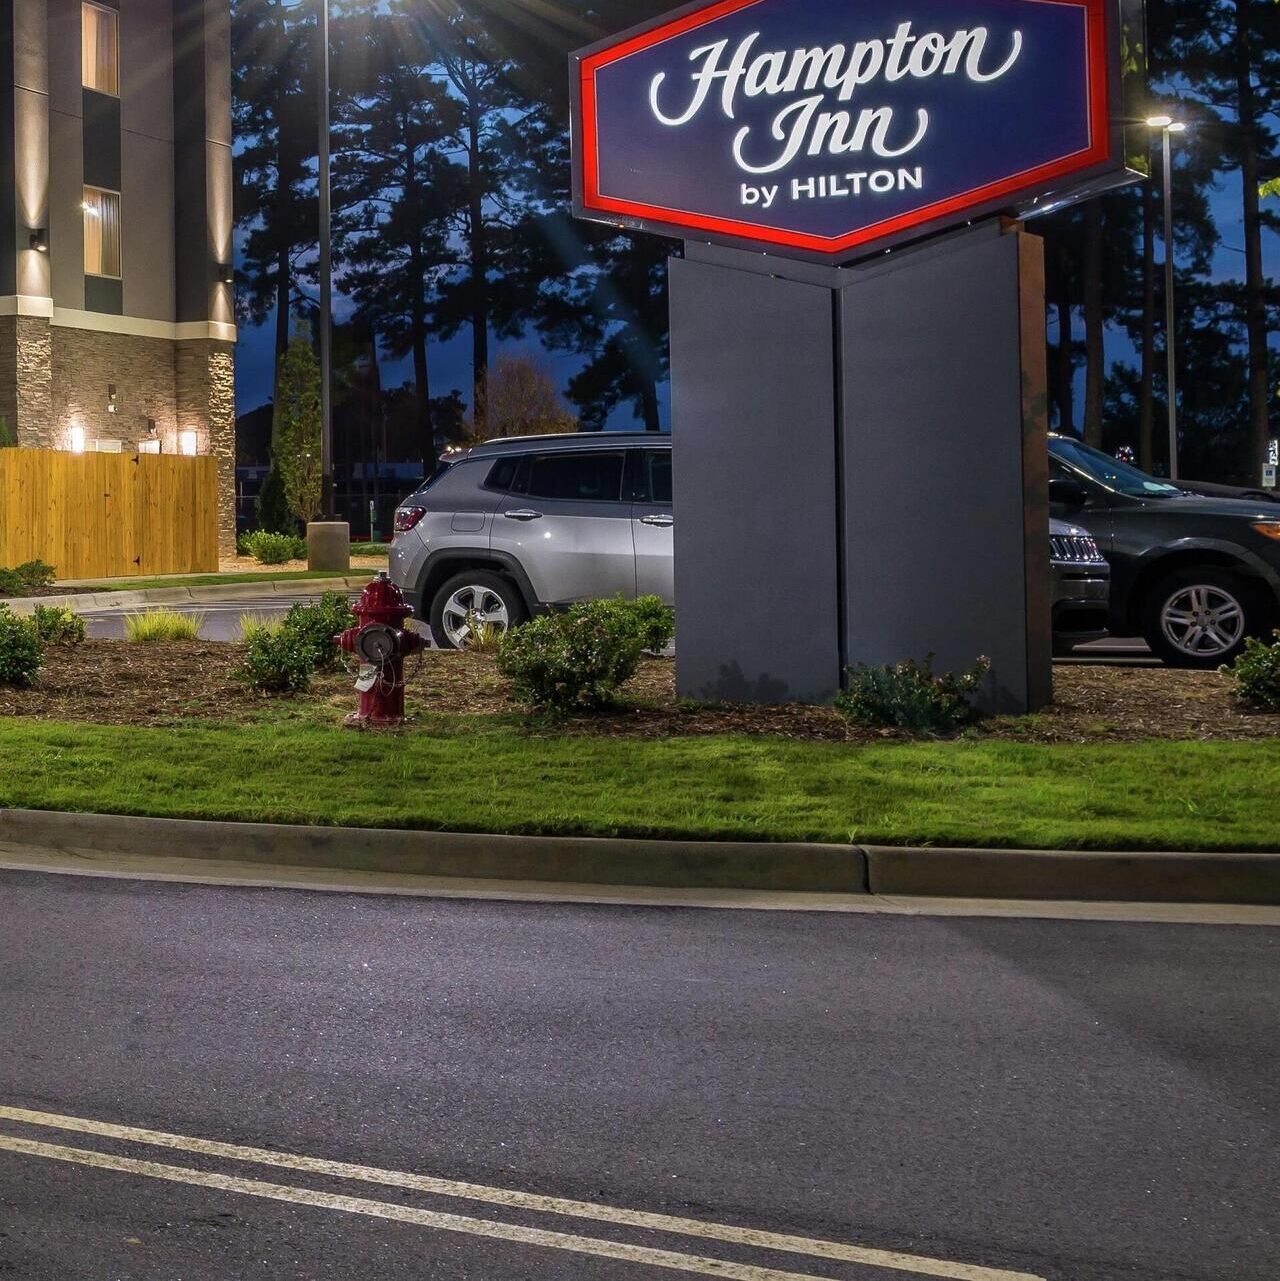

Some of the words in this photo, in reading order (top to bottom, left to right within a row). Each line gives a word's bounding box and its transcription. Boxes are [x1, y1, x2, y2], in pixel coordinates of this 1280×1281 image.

[649, 20, 1023, 126] Hampton
[732, 94, 929, 174] Inn
[740, 182, 779, 209] by
[791, 166, 923, 200] HILTON
